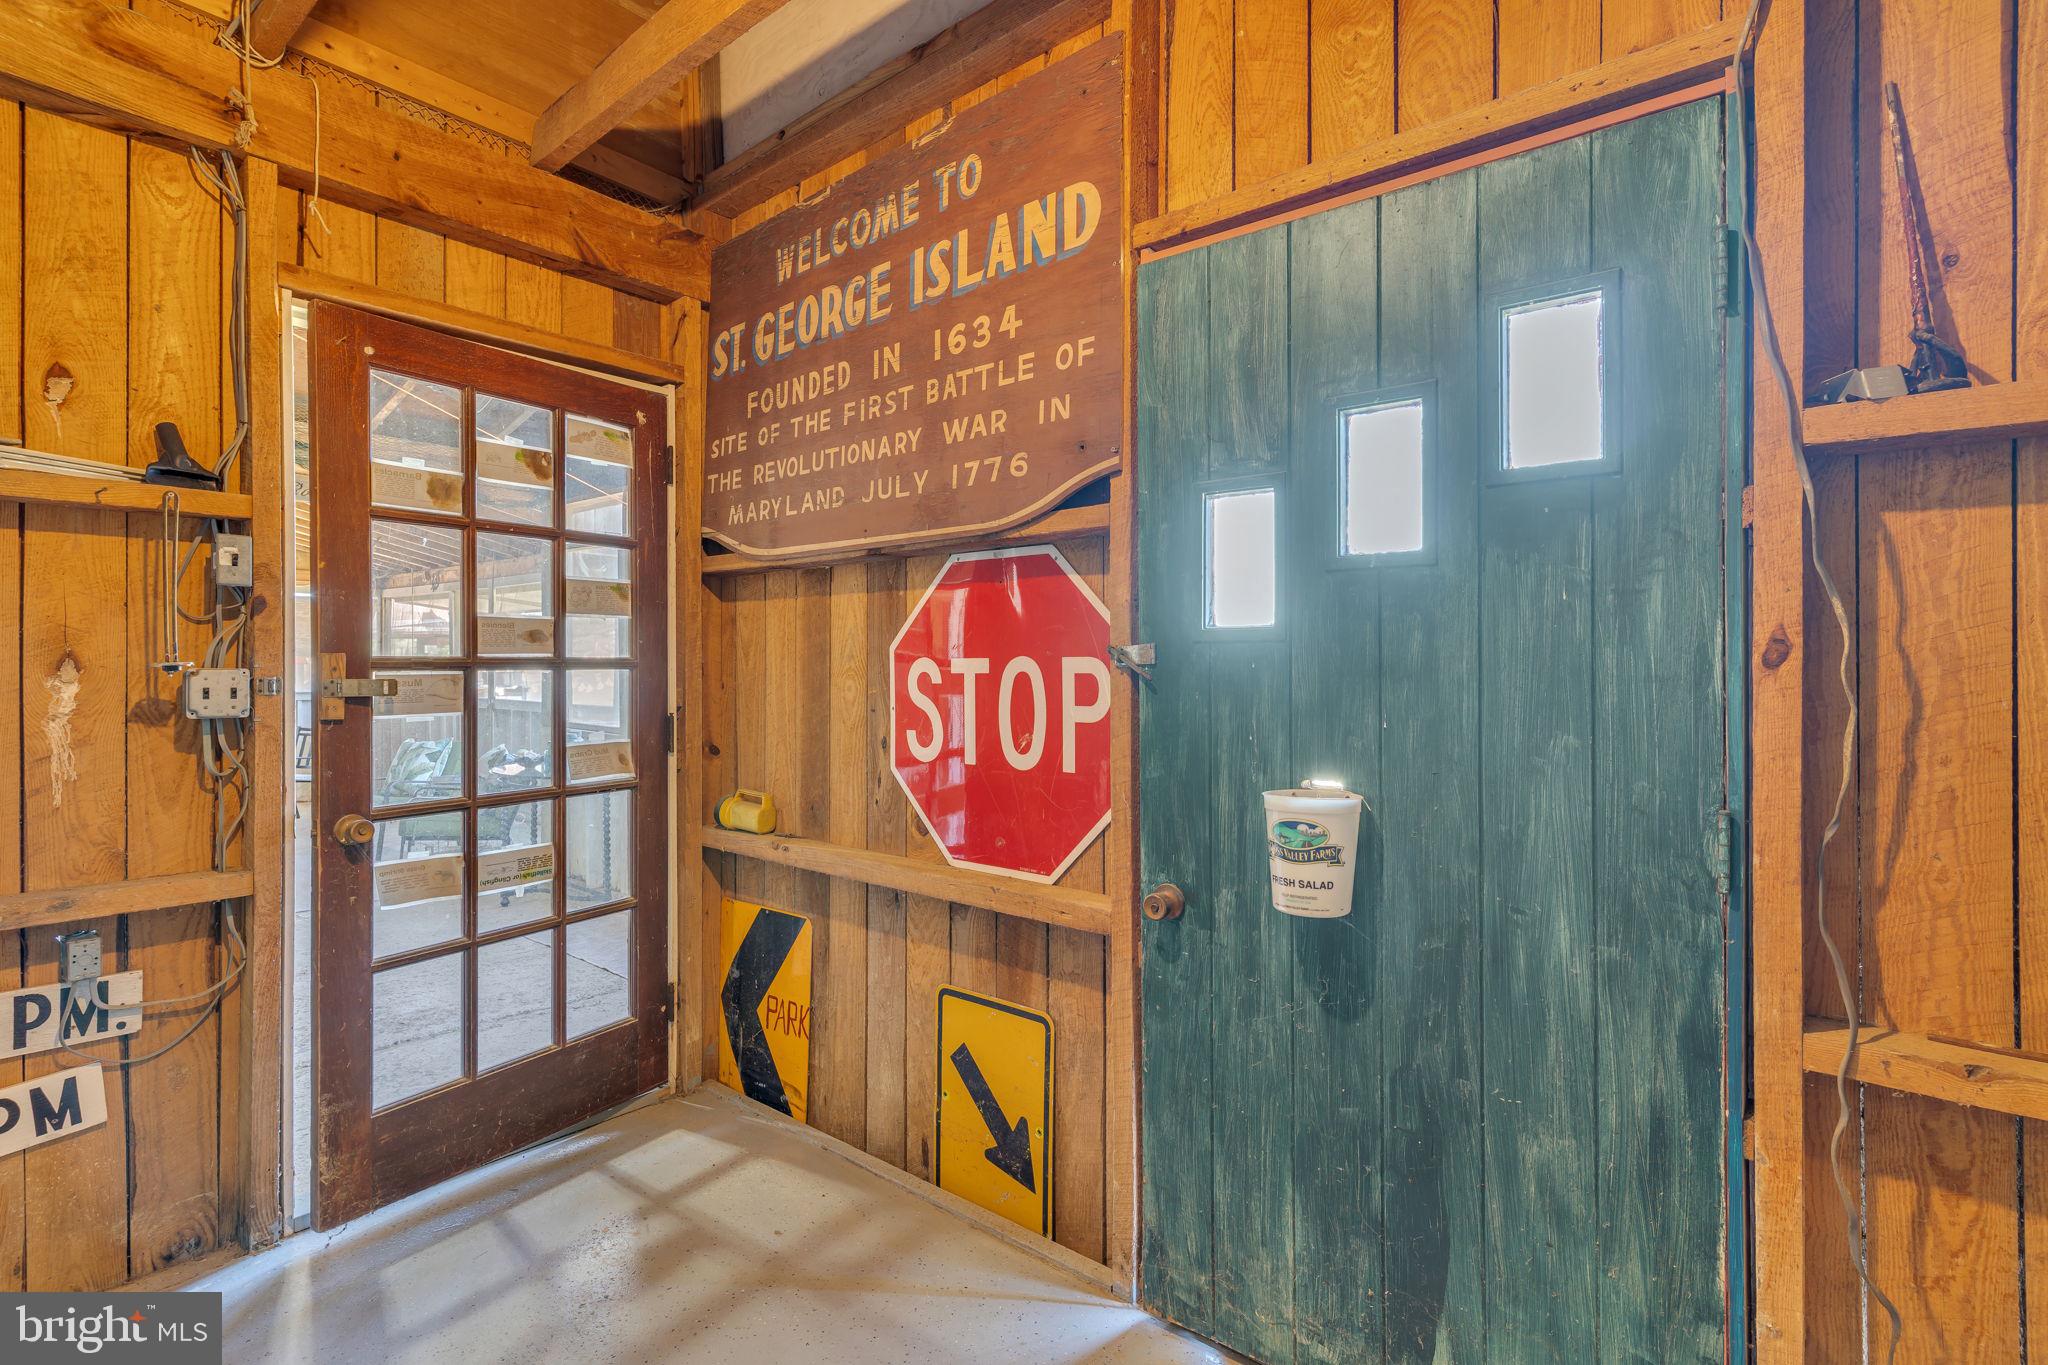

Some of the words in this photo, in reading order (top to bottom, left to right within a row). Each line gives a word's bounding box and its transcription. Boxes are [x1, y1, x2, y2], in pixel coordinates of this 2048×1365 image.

[776, 178, 921, 286] WELCOME
[932, 152, 984, 213] TO
[711, 321, 747, 380] ST.
[752, 259, 894, 366] GEORGE
[909, 179, 1103, 311] ISLAND
[711, 431, 748, 460] SITE
[757, 426, 781, 446] OF
[790, 413, 832, 438] THE
[842, 384, 914, 427] FIRST
[925, 351, 1036, 405] BATTLE
[1055, 335, 1097, 371] OF
[746, 359, 851, 419] FOUNDED
[872, 342, 902, 381] IN
[933, 303, 1024, 361] 1634
[707, 471, 743, 495] THE
[752, 427, 923, 486] REVOLUTIONARY
[942, 409, 1009, 445] WAR
[1038, 393, 1072, 425] IN
[728, 485, 846, 526] MARYLAND
[861, 469, 930, 505] JULY
[951, 451, 1030, 490] 1776
[905, 655, 1112, 774] STOP
[480, 876, 511, 886] Clingfish)
[1272, 874, 1296, 888] FRESH
[1298, 879, 1334, 890] SALAD
[766, 994, 810, 1040] PARK
